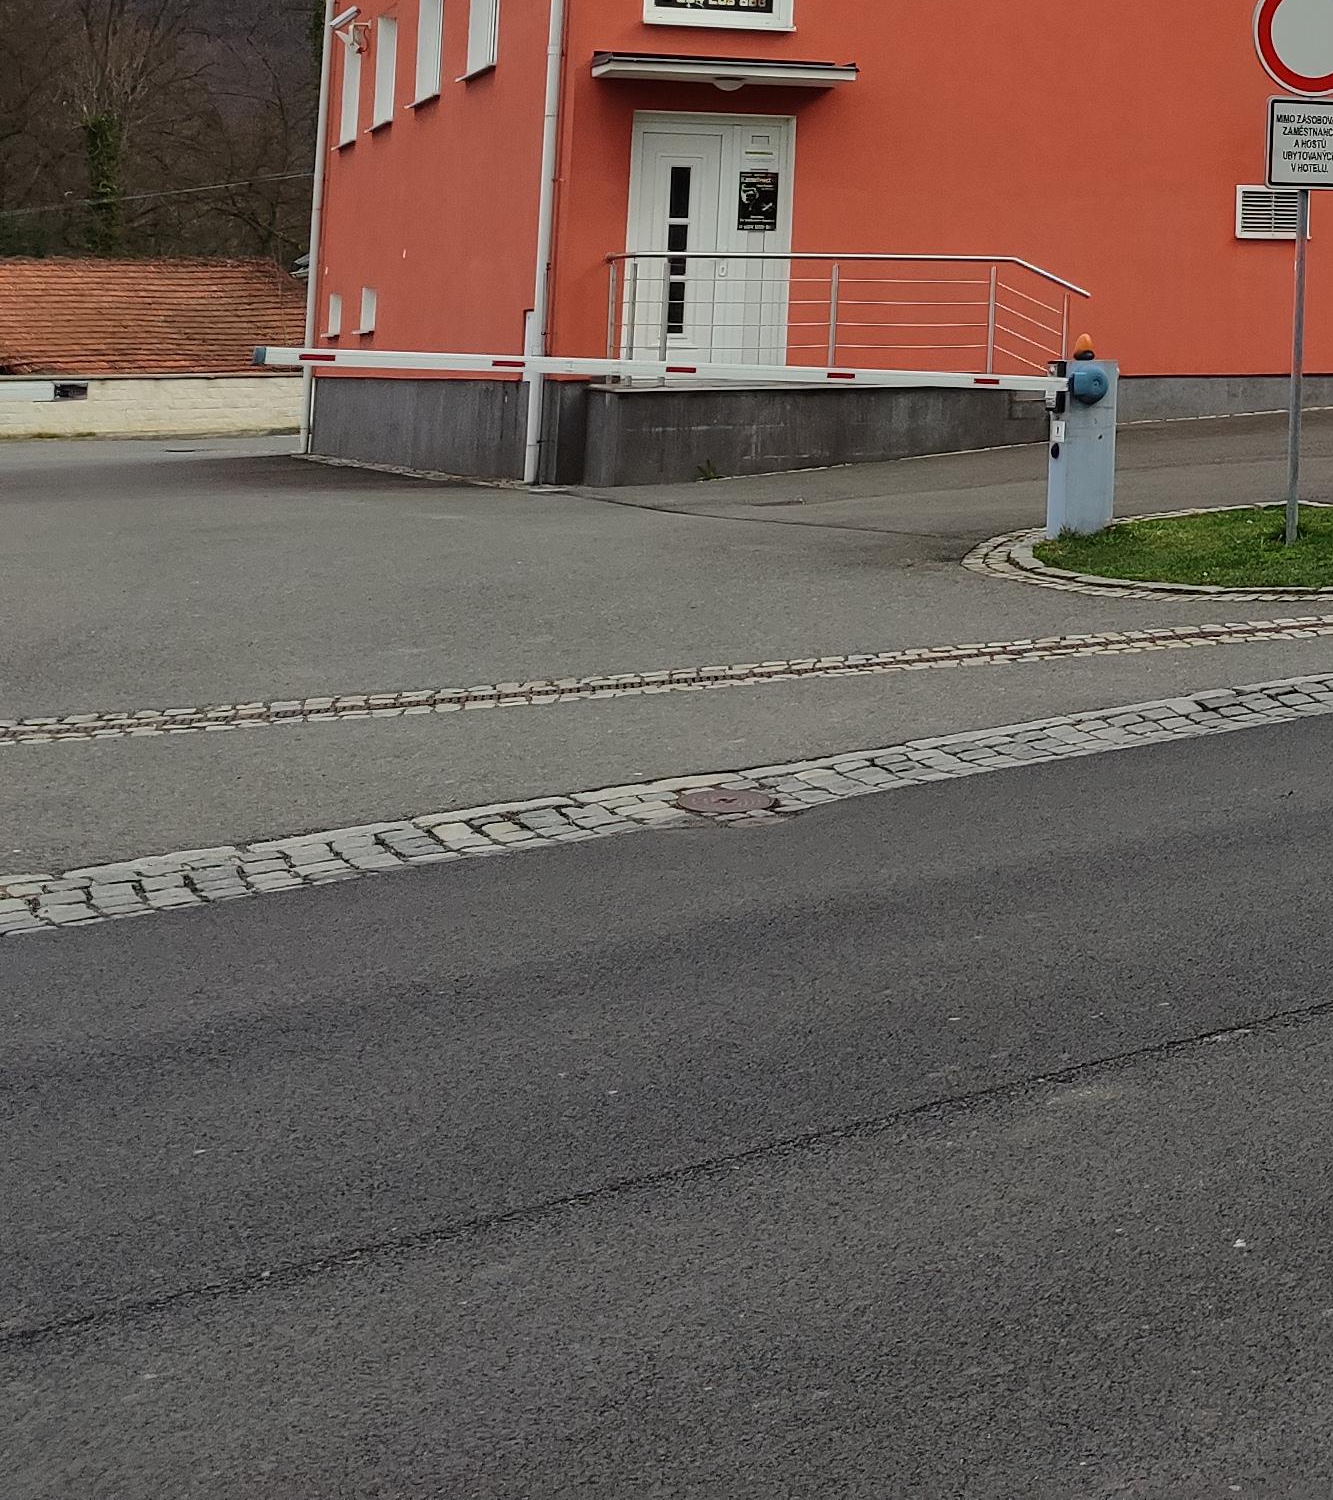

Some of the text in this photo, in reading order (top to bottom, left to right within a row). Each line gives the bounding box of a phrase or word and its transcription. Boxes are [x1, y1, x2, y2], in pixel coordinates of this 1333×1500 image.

[1277, 115, 1295, 123] MIMO
[1294, 139, 1299, 148] A
[1291, 163, 1296, 172] V
